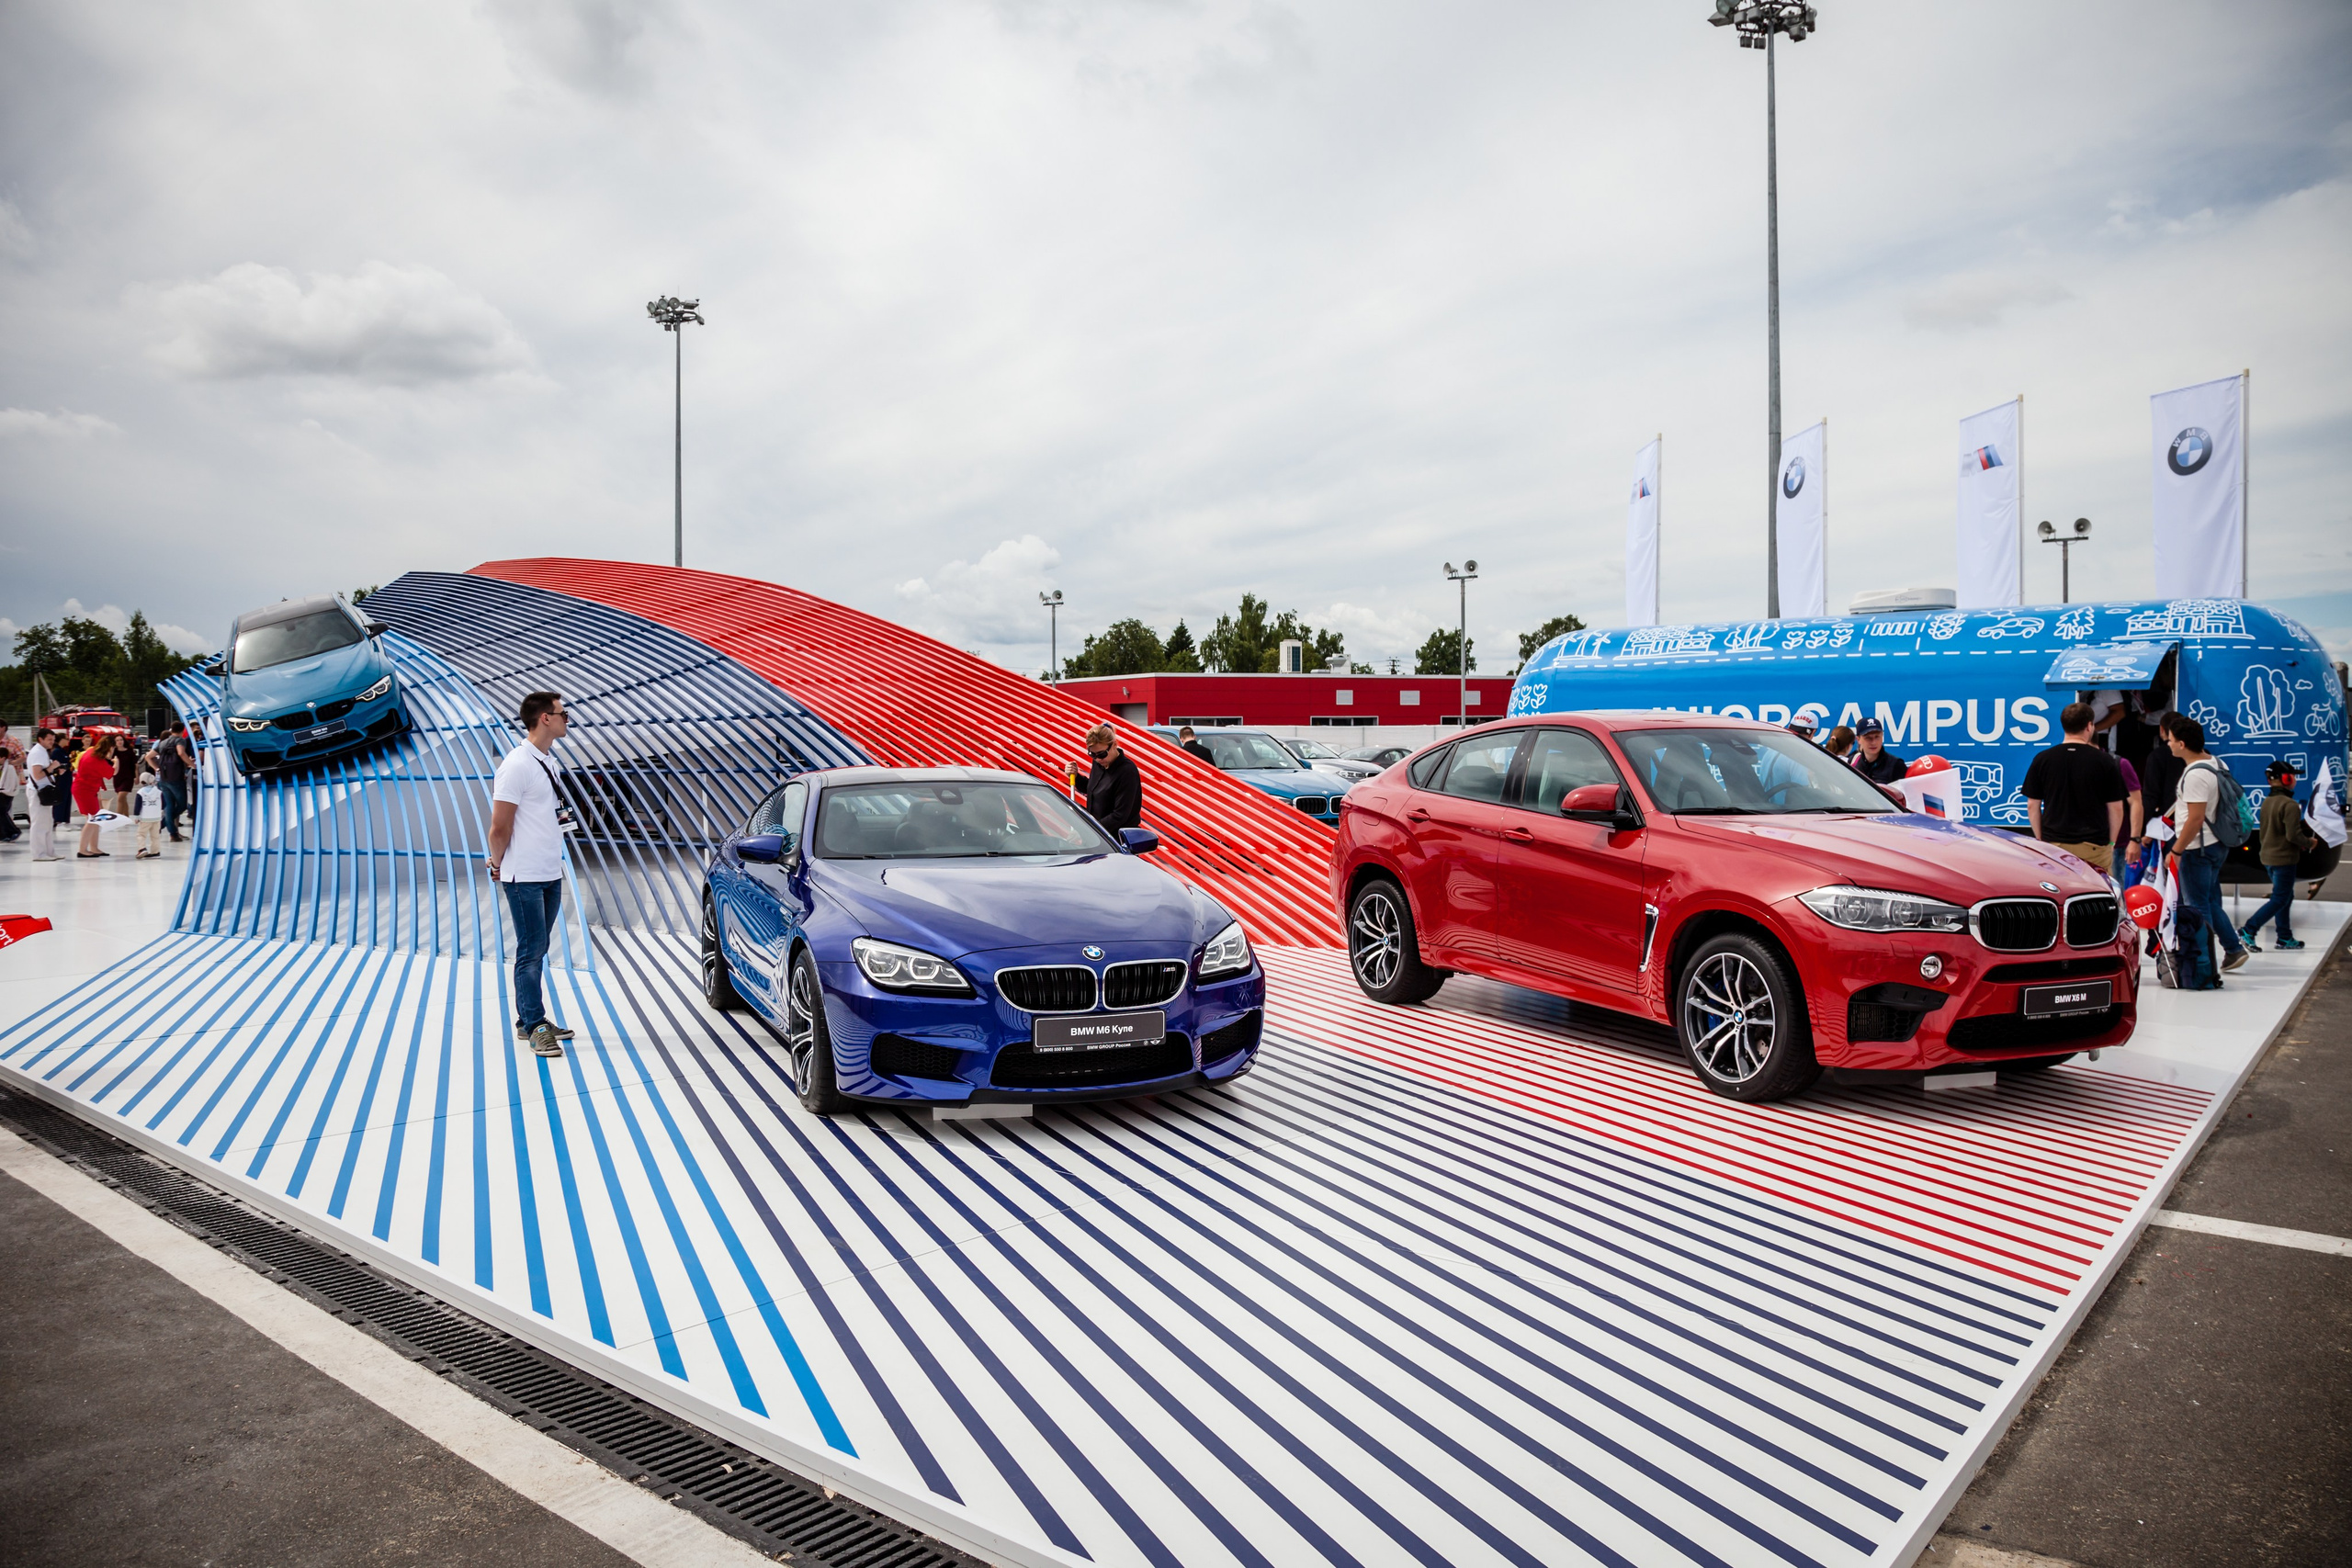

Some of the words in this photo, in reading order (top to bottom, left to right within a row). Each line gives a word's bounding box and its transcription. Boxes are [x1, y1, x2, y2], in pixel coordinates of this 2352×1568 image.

[2054, 995, 2072, 1004] BMW
[2072, 993, 2080, 1002] X6
[2080, 992, 2086, 1001] M
[1070, 1026, 1095, 1036] BMW
[1096, 1025, 1111, 1034] M6
[1112, 1024, 1134, 1035] Купе
